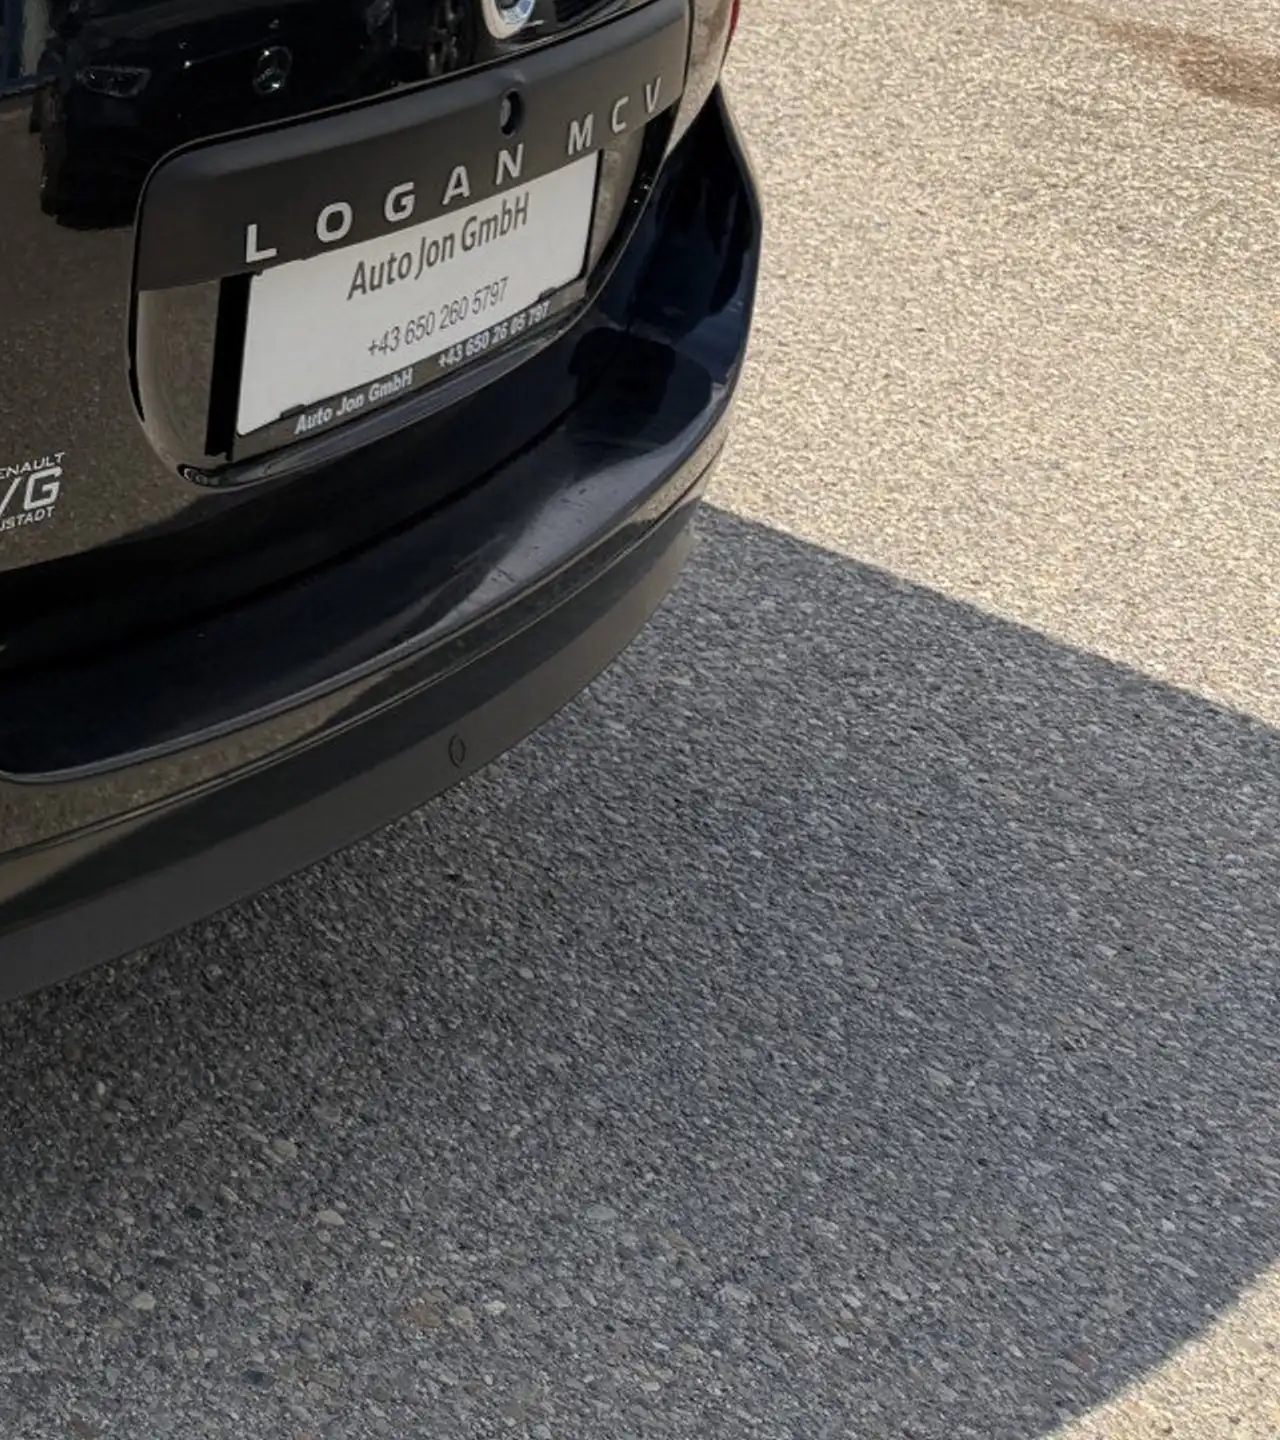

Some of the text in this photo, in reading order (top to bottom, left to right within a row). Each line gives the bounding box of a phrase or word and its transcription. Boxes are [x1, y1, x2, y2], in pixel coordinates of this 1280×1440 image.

[245, 77, 662, 263] LOGAN MCV
[347, 192, 530, 301] Auto Jon GmbH
[368, 276, 510, 356] +43 650 260 5797
[294, 405, 333, 435] Auto
[337, 392, 364, 416] Jon
[368, 367, 414, 402] GmbH
